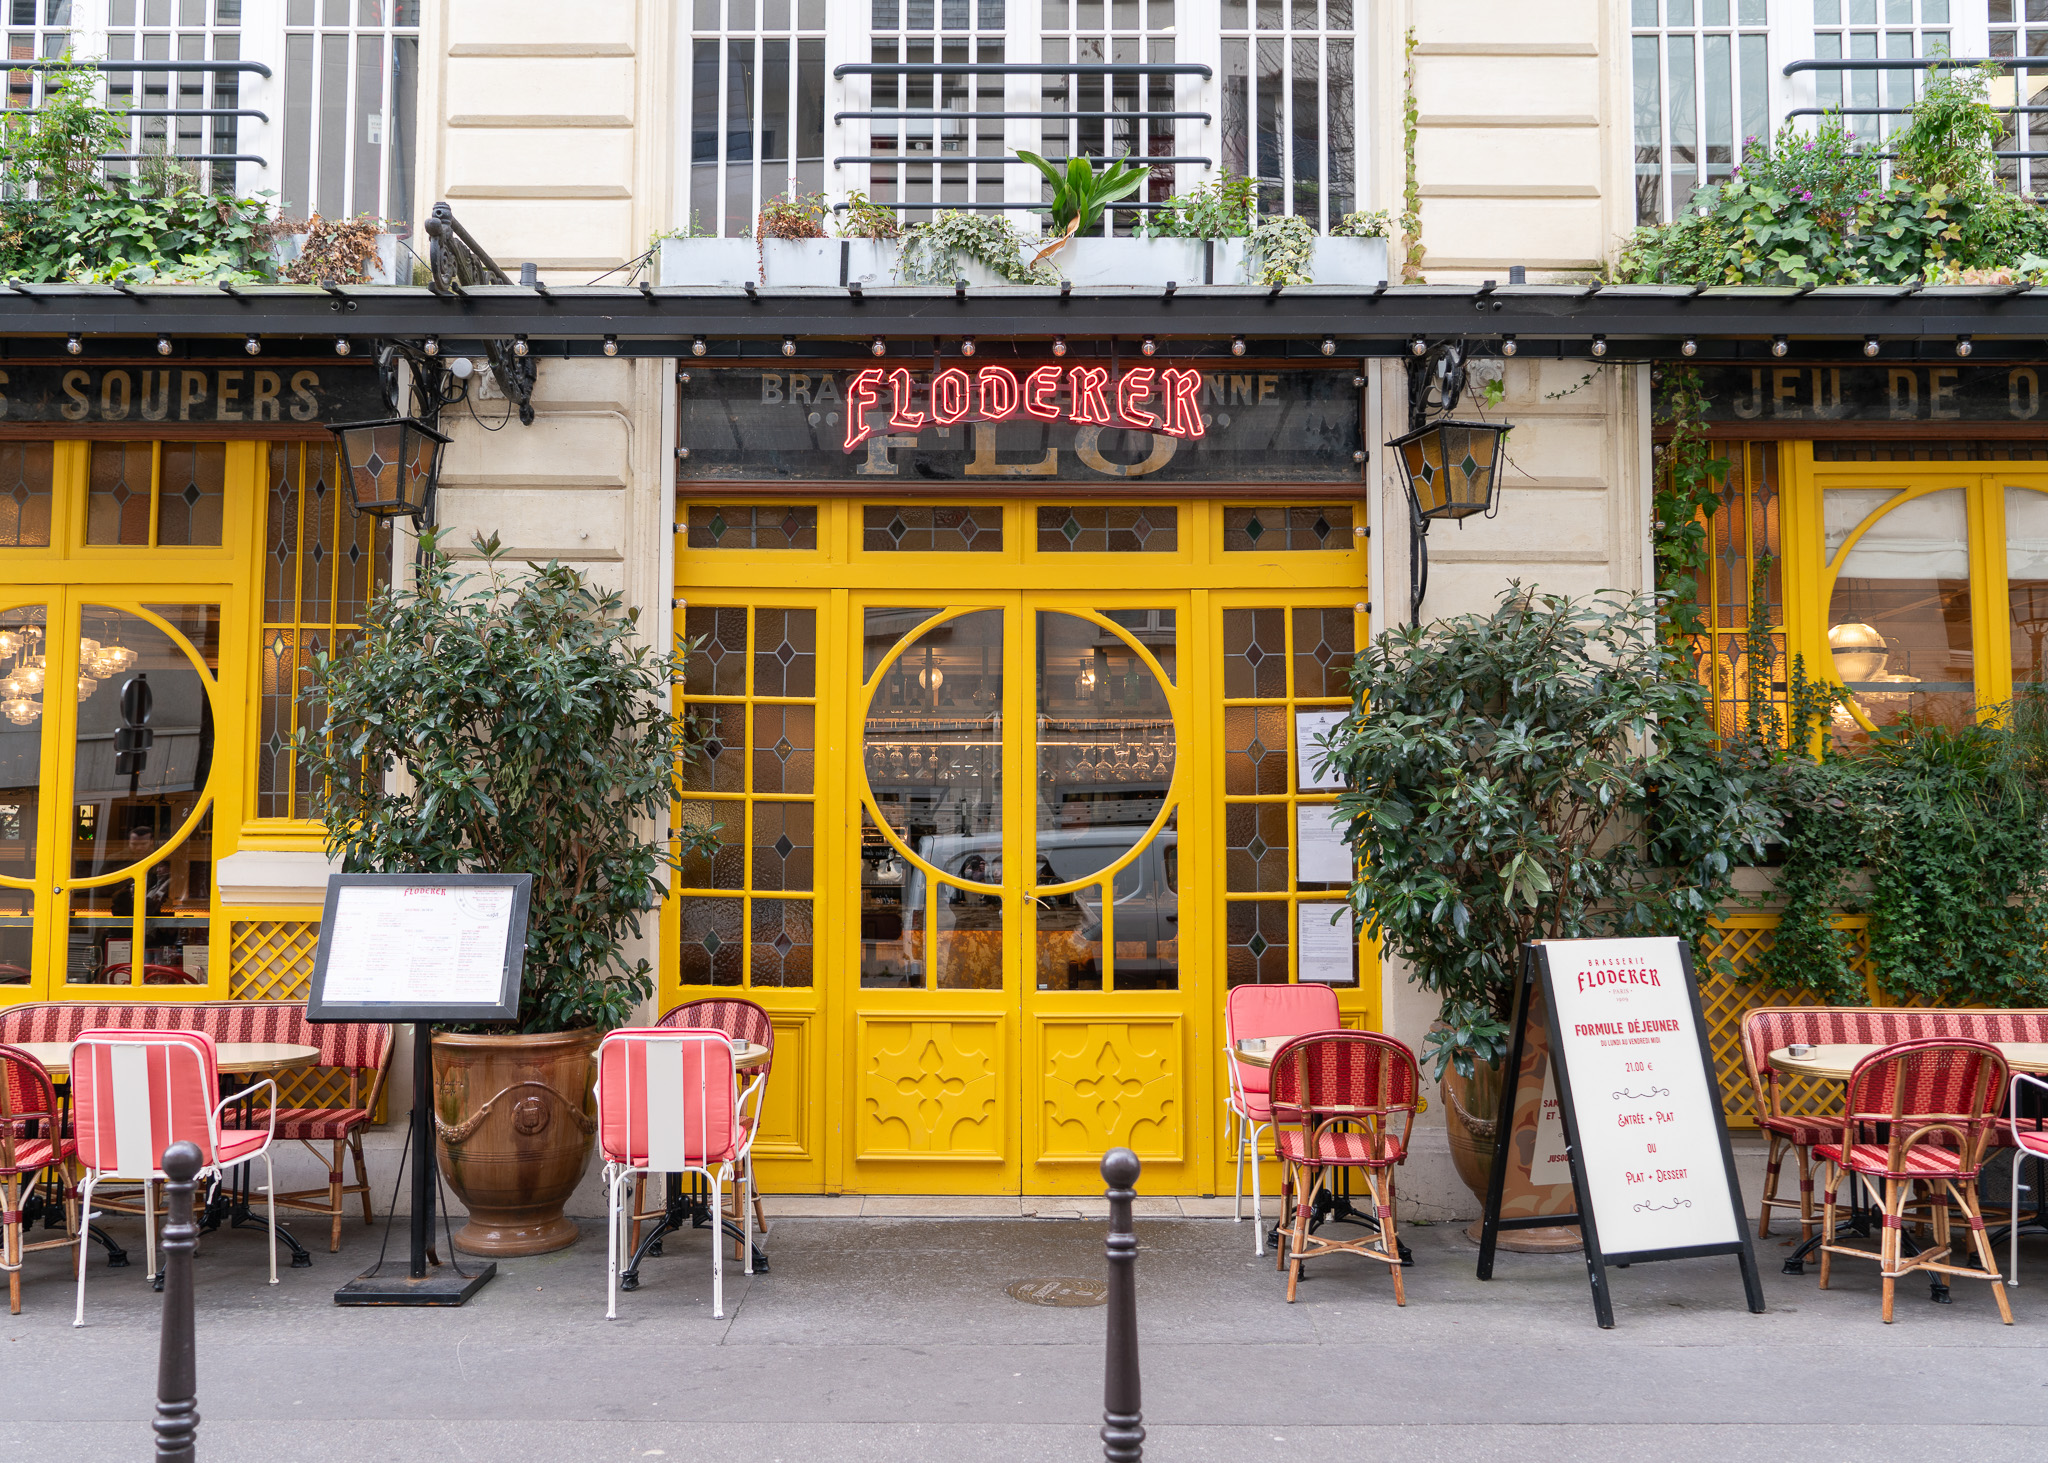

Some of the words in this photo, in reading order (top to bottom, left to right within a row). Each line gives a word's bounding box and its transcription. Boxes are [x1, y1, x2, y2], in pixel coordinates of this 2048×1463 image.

[61, 369, 320, 421] SOUPERS
[1733, 368, 1842, 420] JEU
[1888, 368, 1960, 419] DE
[844, 366, 1204, 448] FLODERER
[1588, 957, 1644, 967] BRASSERIE
[1577, 969, 1661, 994] FLODERER
[1574, 1022, 1624, 1037] FORMULE
[1627, 1018, 1680, 1034] DÉJEUNER
[1629, 1037, 1650, 1045] VENDREDI
[1625, 1061, 1644, 1072] 21.00
[1647, 1062, 1653, 1071] €
[1647, 1143, 1657, 1153] OU
